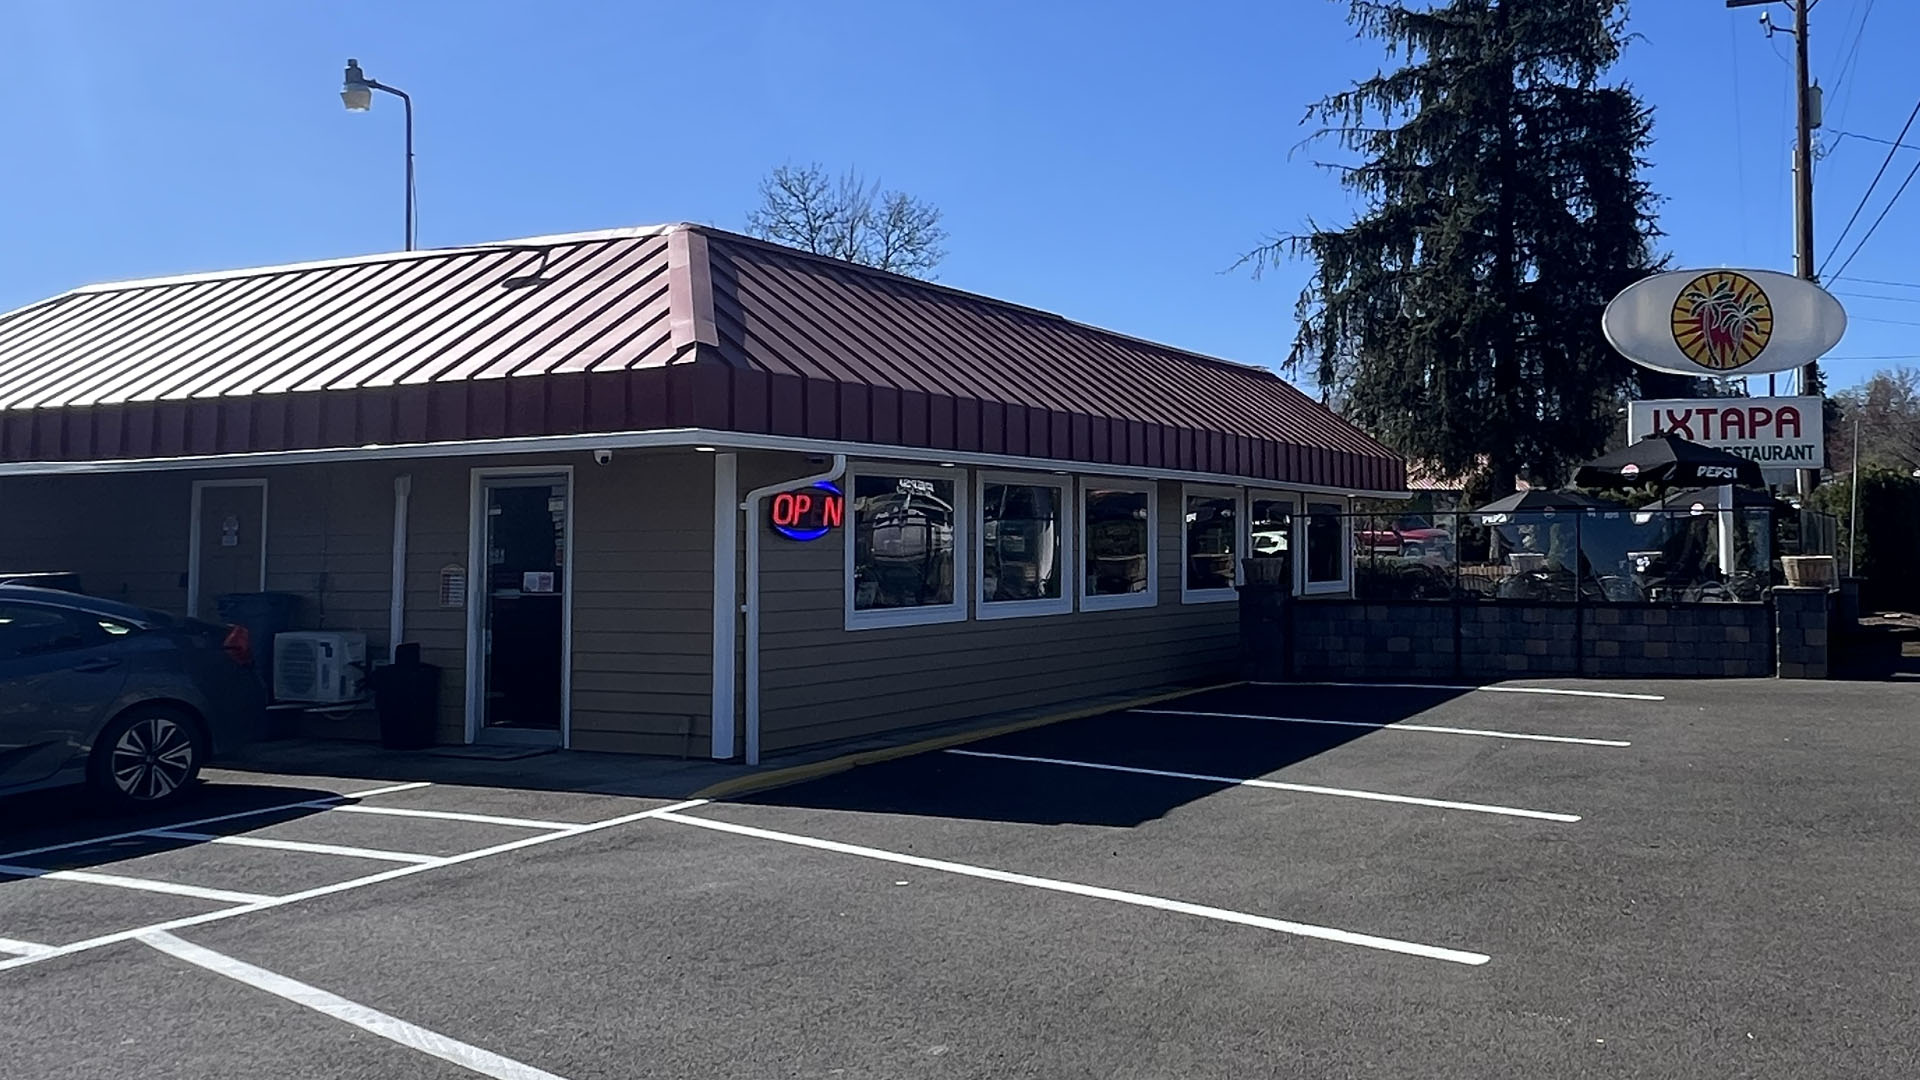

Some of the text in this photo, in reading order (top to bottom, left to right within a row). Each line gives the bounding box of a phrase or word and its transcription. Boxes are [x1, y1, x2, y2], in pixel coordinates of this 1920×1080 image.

[1653, 406, 1801, 440] IXTAPA
[1696, 466, 1738, 479] PEPSI
[772, 493, 844, 528] OPN
